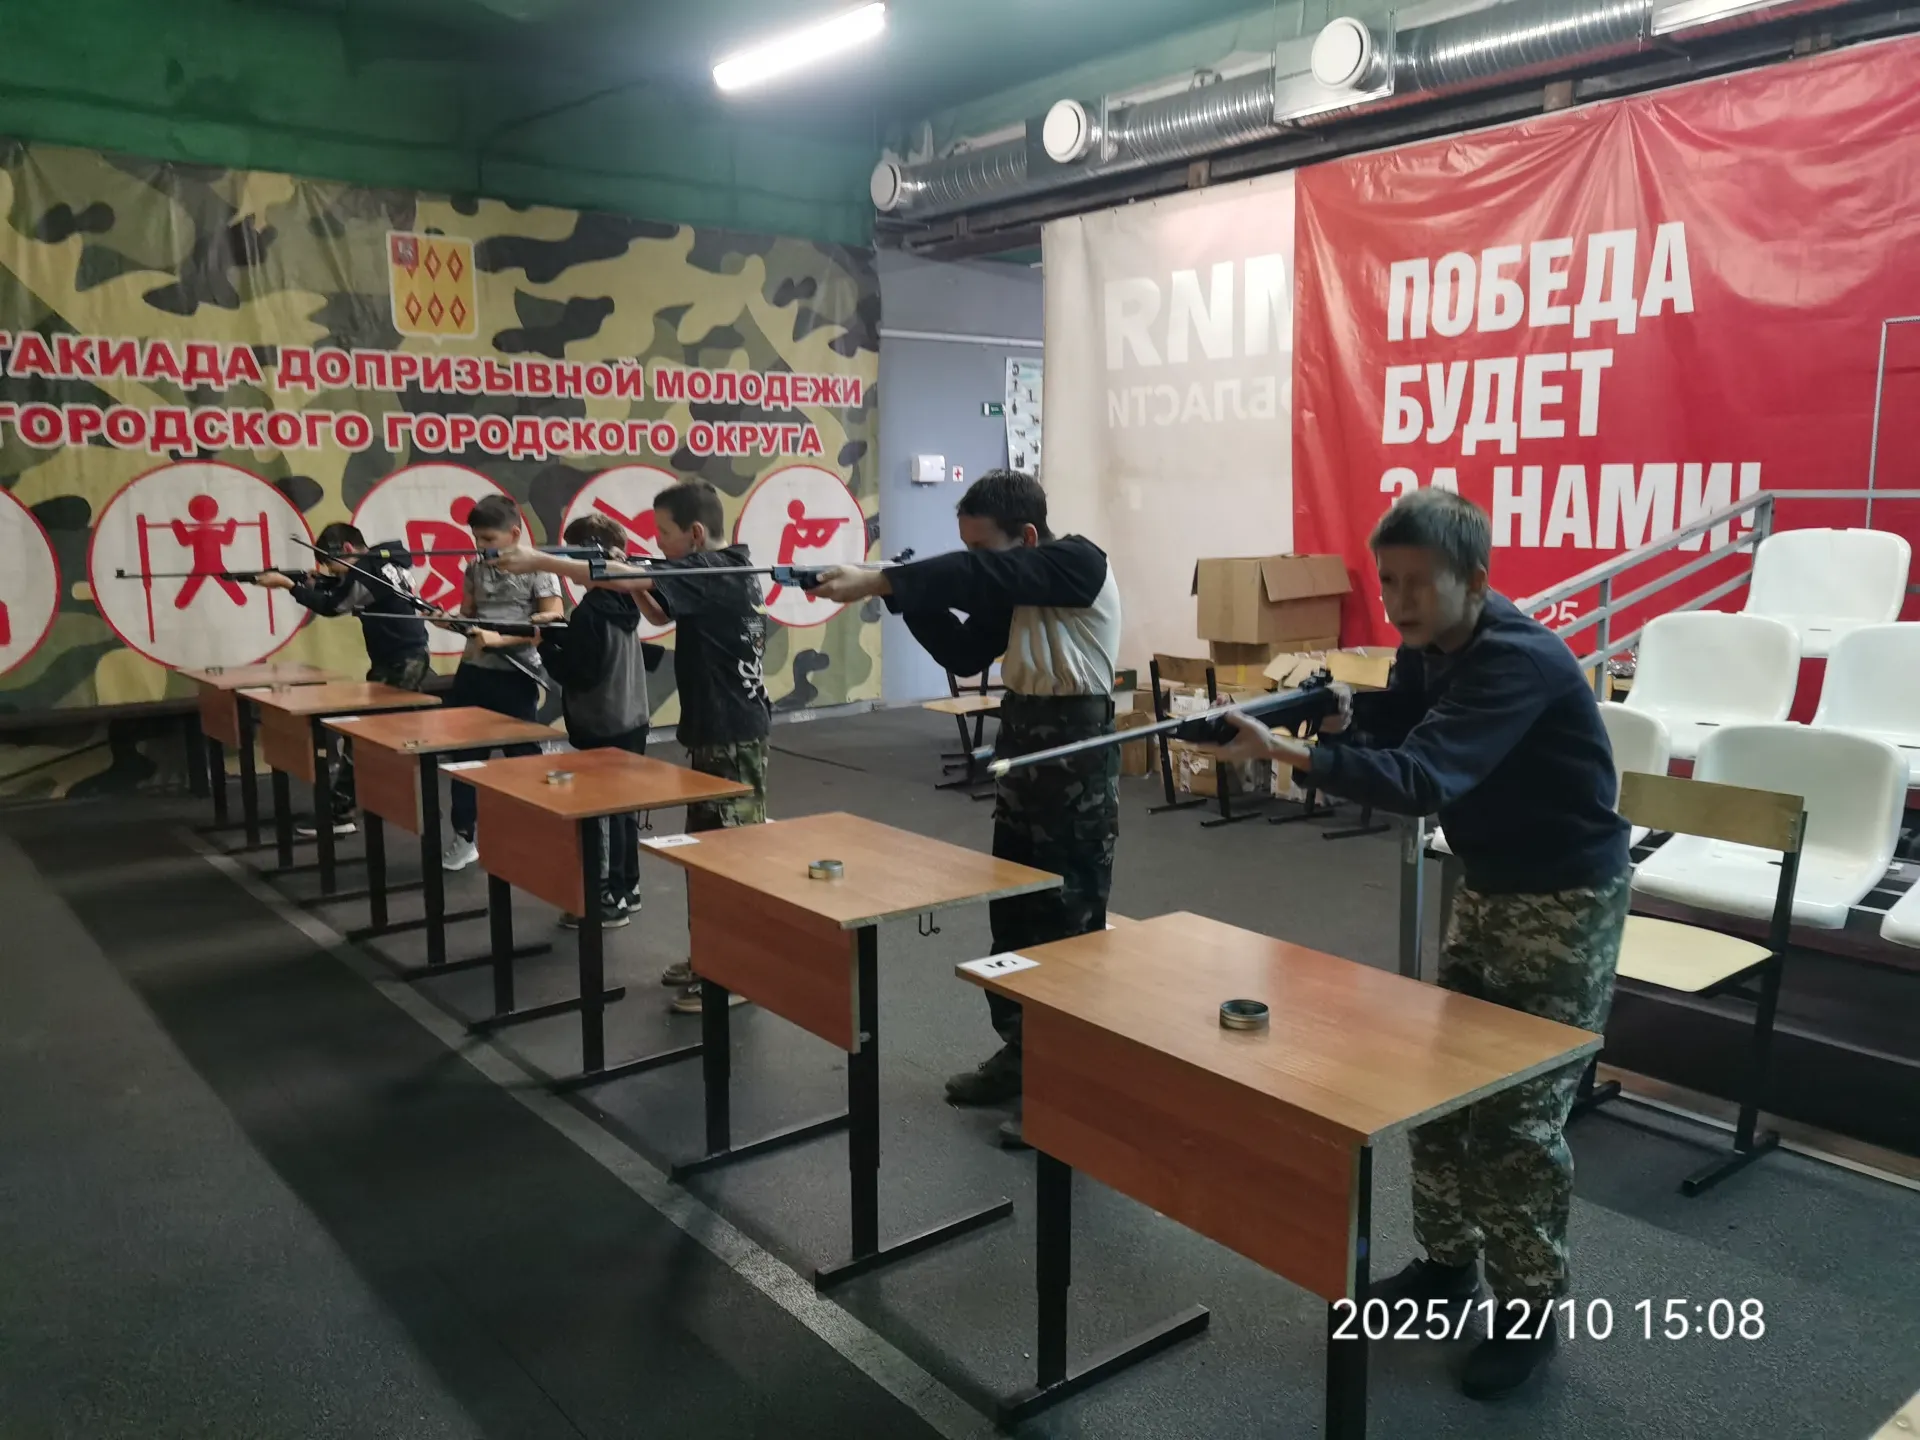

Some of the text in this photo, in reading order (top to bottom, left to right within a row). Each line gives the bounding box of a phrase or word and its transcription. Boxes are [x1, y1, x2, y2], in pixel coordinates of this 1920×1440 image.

[1386, 220, 1695, 341] ПОБЕДА
[276, 348, 643, 398] ДОПРИЗЫВНОЙ
[655, 368, 862, 408] МОЛОДЕЖИ
[1381, 348, 1614, 456] БУДЕТ
[386, 415, 677, 457] ГОРОДСКОГО
[688, 423, 822, 454] ОКРУГА
[1491, 462, 1762, 553] НАМИ!
